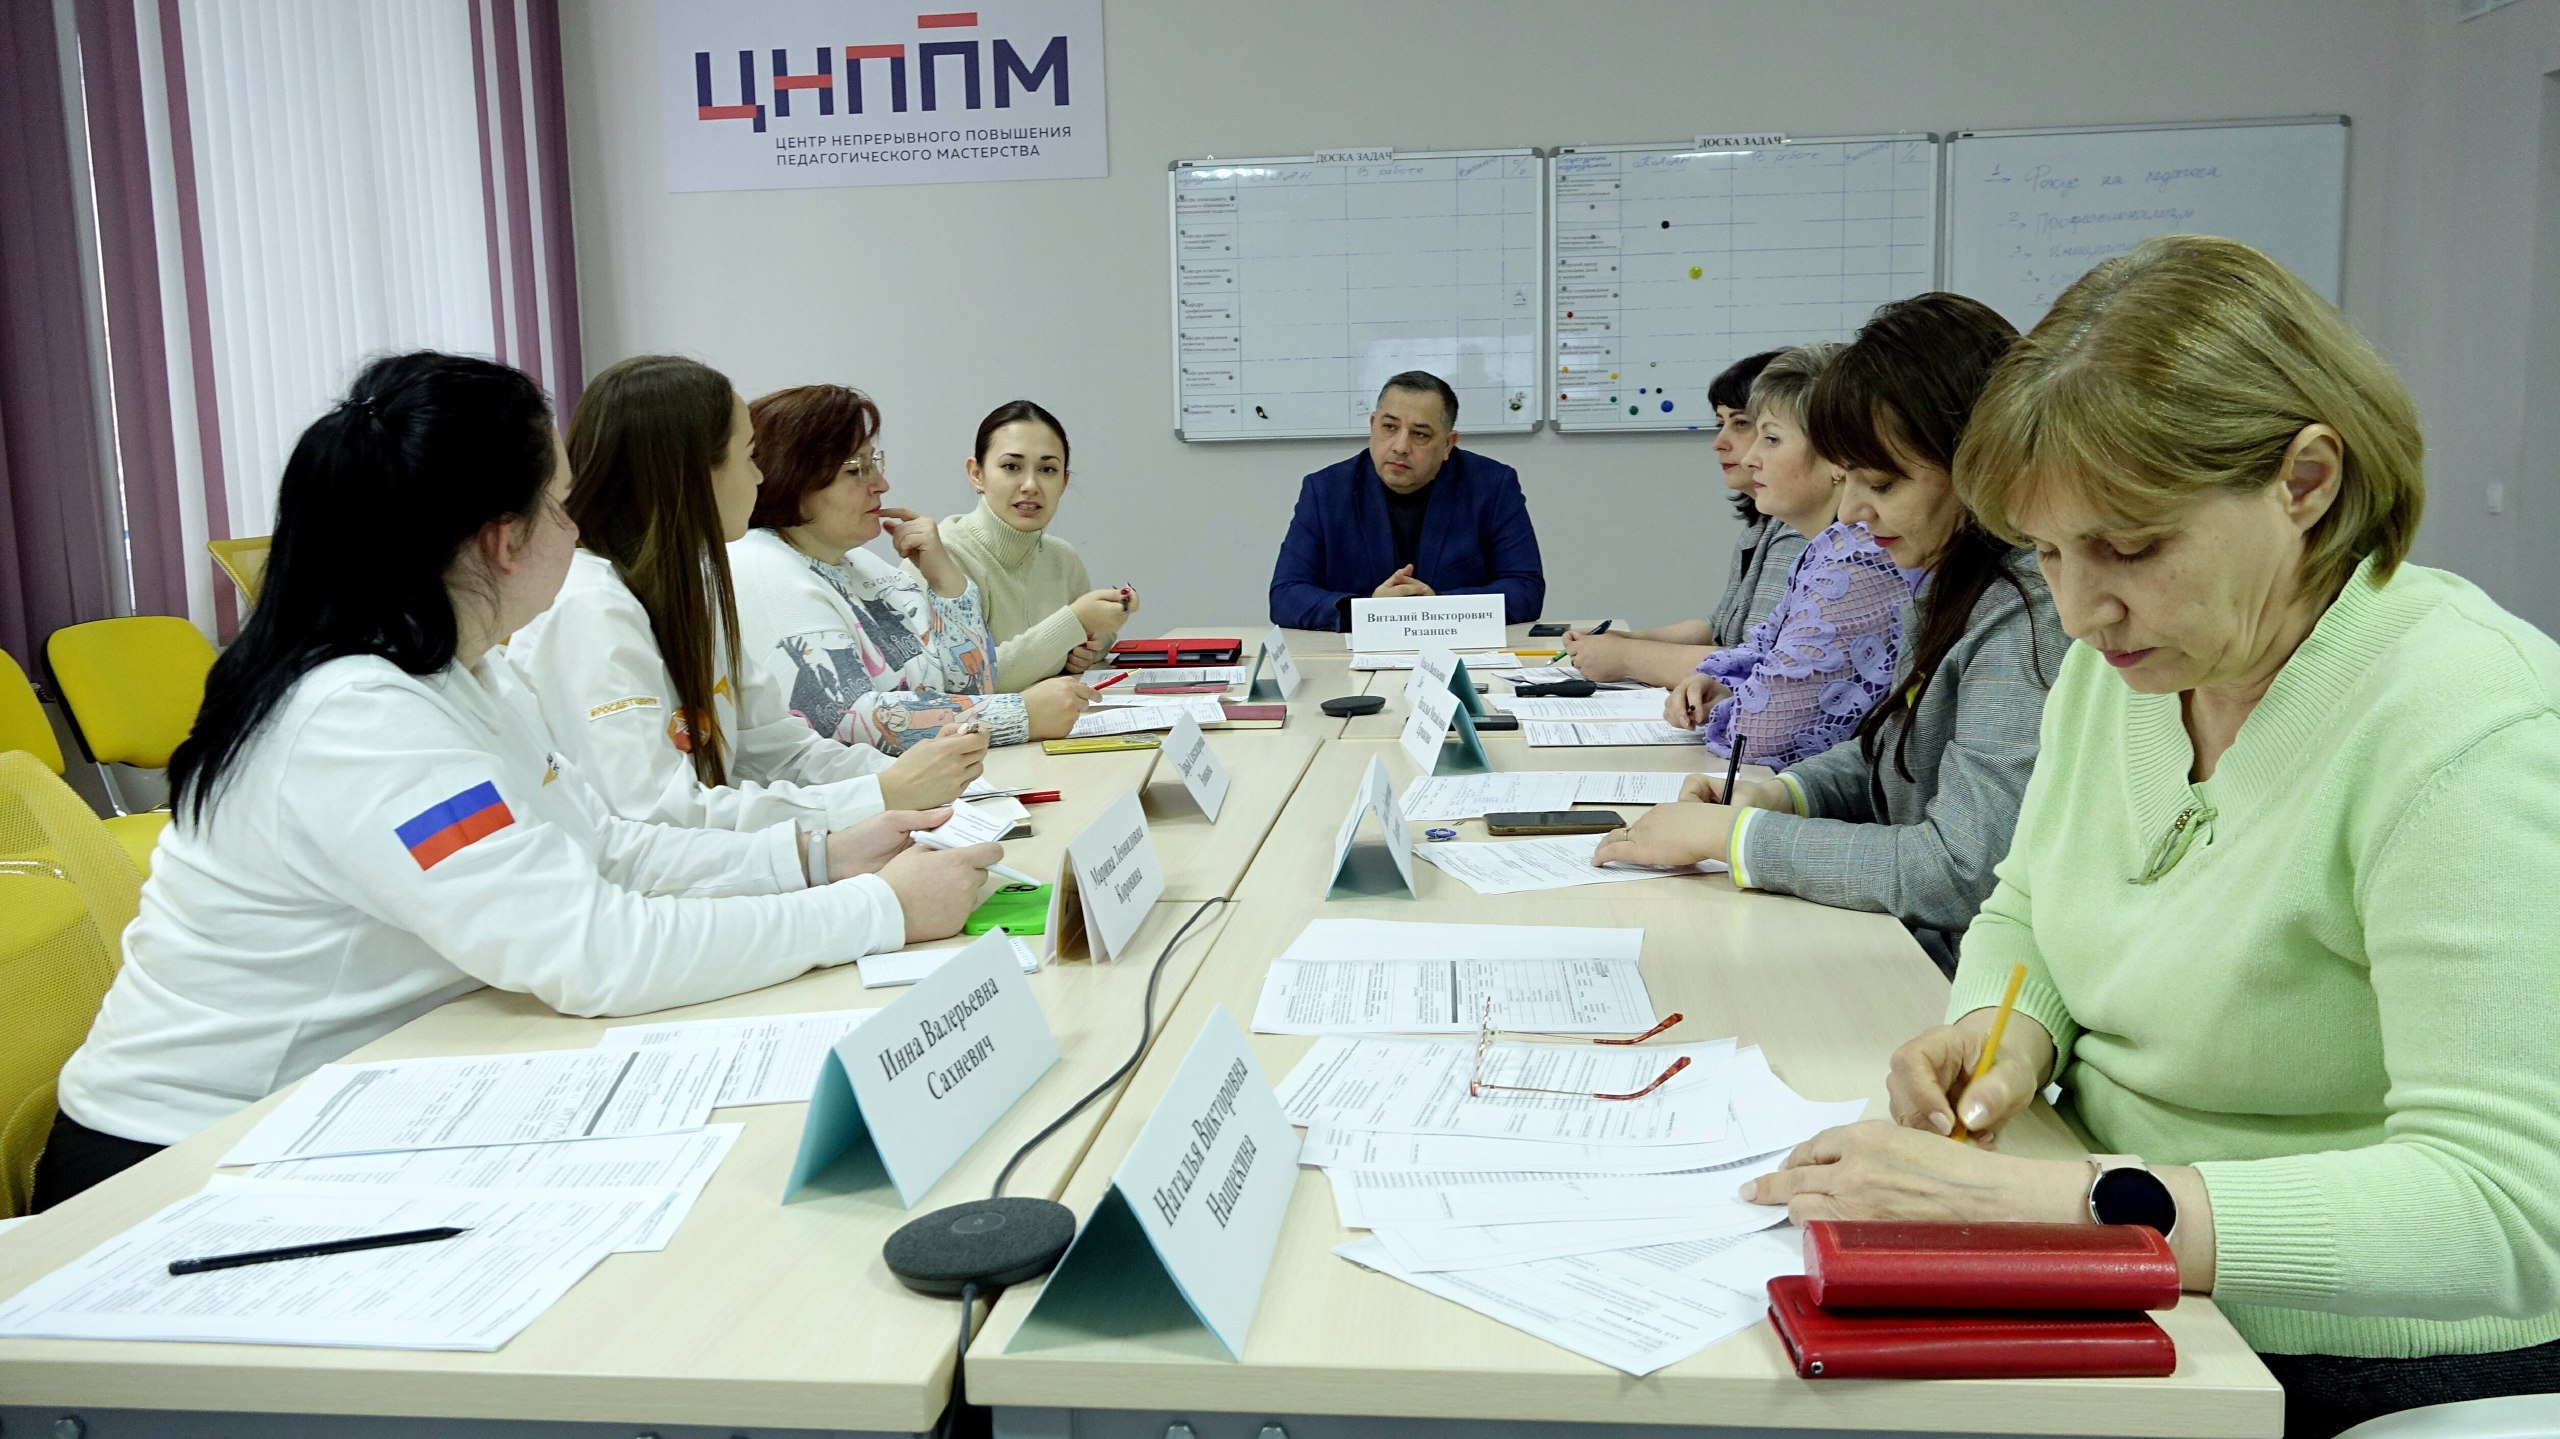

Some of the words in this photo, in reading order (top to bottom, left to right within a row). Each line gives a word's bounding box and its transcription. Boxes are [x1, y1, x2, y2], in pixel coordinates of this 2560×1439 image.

[695, 13, 1070, 134] ЦНППМ
[775, 136, 827, 151] ЦЕНТР
[831, 131, 961, 148] НЕПРЕРЫВНОГО
[965, 126, 1072, 142] ПОВЫШЕНИЯ
[1699, 138, 1740, 149] ДОСКА
[1743, 136, 1782, 147] ЗАДАЧ
[776, 148, 932, 167] ПЕДАГОГИЧЕСКОГО
[936, 144, 1040, 161] МАСТЕРСТВА
[1315, 152, 1354, 164] ДОСКА
[1356, 151, 1393, 162] ЗАДАЧ
[1367, 611, 1418, 623] Виталий
[1421, 610, 1493, 623] Викторович
[1403, 626, 1458, 637] Рязанцев
[1089, 856, 1117, 889] Марина
[1113, 867, 1144, 904] Коровина
[876, 1036, 926, 1083] Инна
[919, 977, 1000, 1049] Валерьевна
[926, 1034, 997, 1101] Сахневич
[1151, 1140, 1206, 1229] Наталья
[1191, 1056, 1250, 1154] Викторовна
